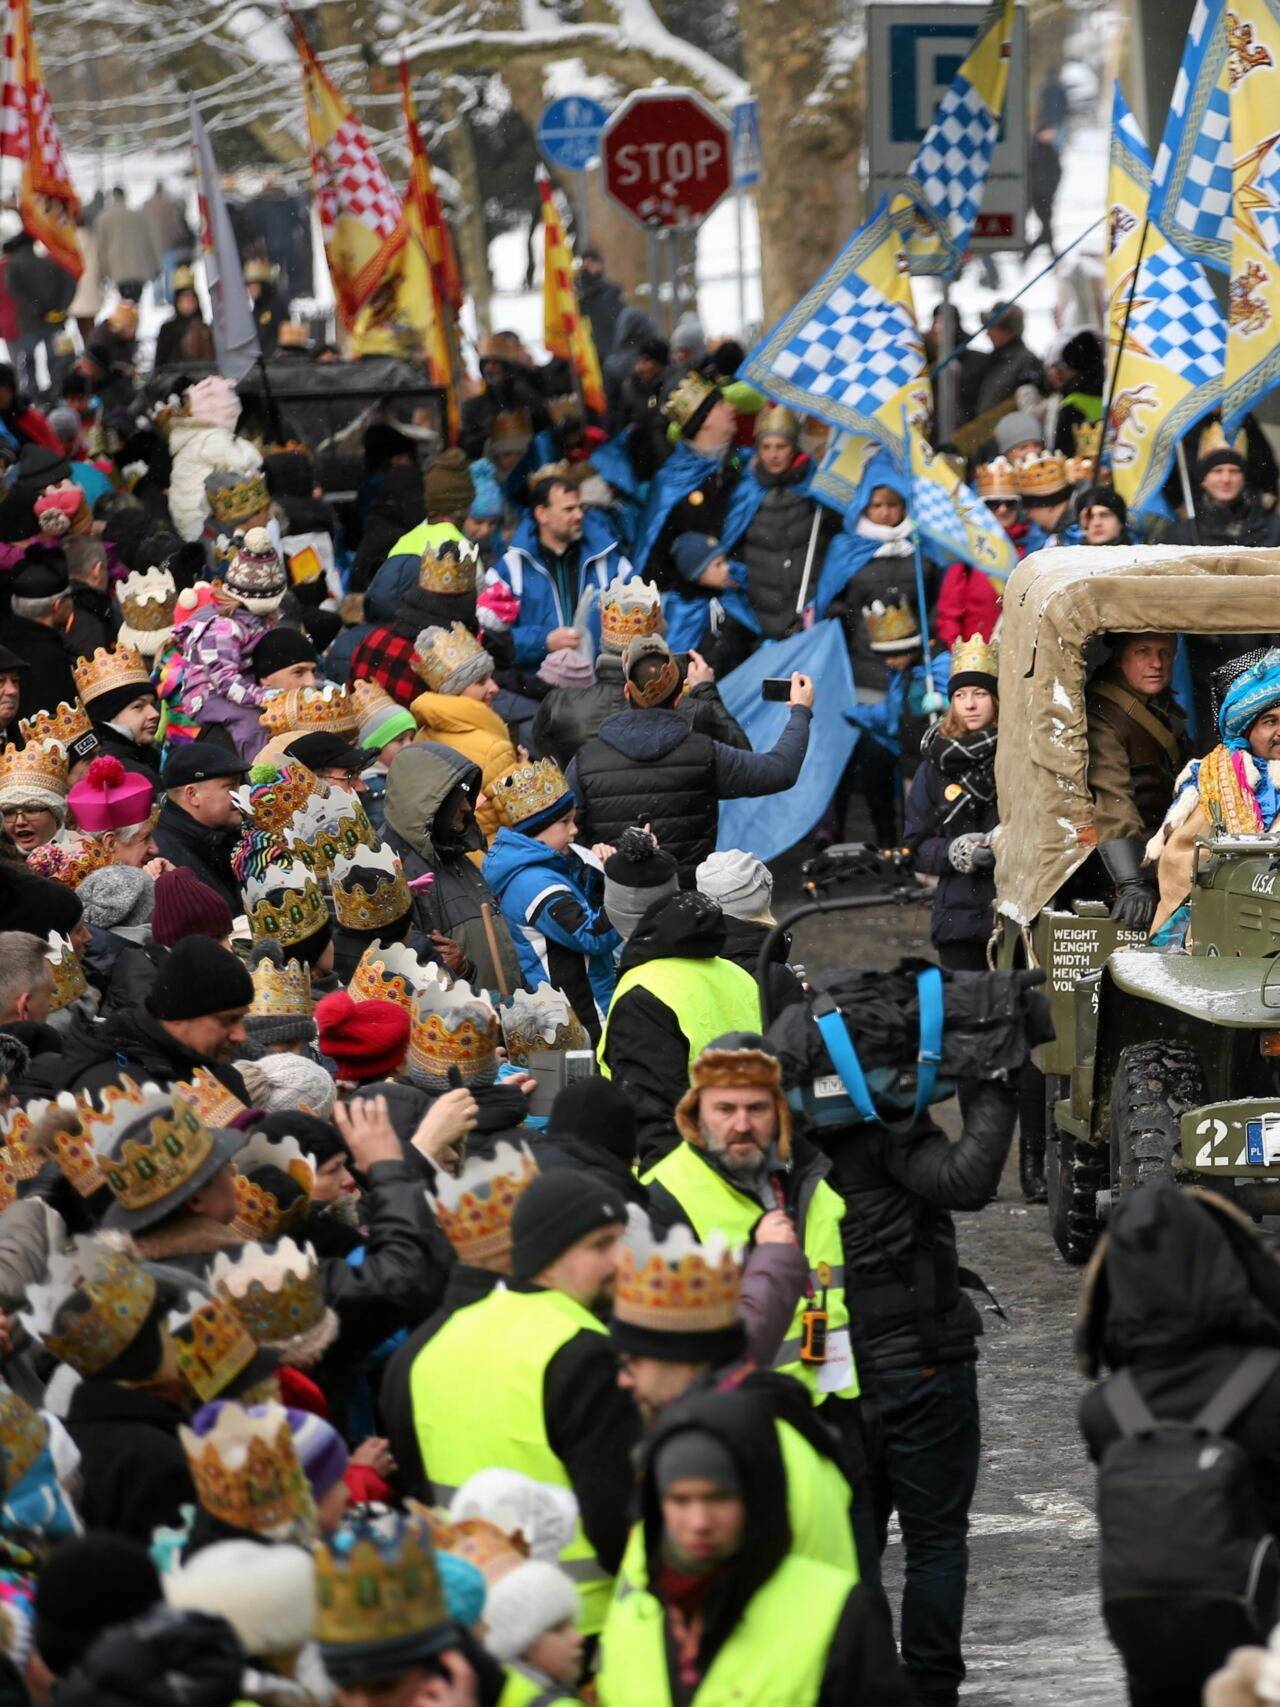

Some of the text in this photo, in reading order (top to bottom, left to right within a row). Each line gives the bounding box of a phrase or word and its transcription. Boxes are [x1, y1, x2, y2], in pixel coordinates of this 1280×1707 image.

[615, 140, 720, 185] STOP
[1251, 873, 1273, 895] U.S.A.
[1053, 929, 1147, 941] WEIGHT 5550
[1053, 942, 1099, 953] LENGHT
[1053, 955, 1090, 966] WIDTH
[1053, 968, 1098, 979] HEIG
[1053, 981, 1075, 992] VOL
[1250, 1147, 1263, 1156] PL
